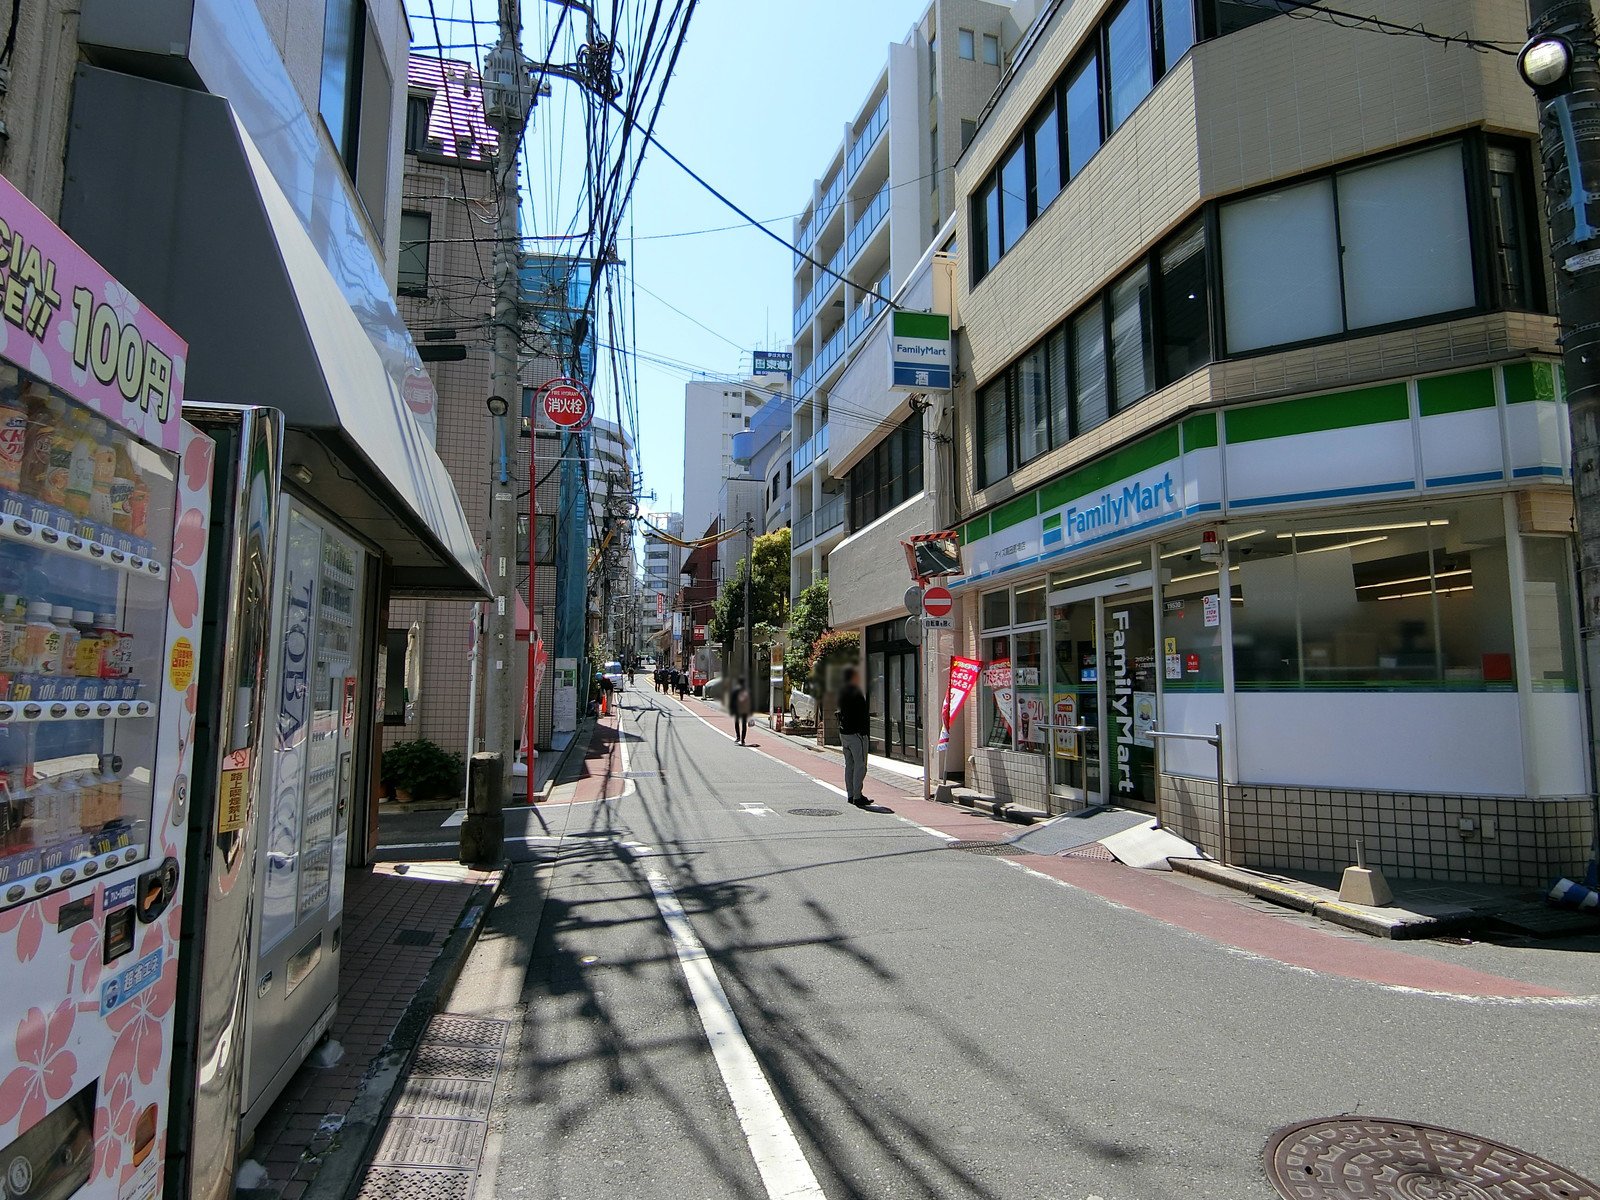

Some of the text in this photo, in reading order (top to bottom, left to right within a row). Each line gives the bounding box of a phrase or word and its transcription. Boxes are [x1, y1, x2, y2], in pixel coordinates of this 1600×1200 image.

[73, 285, 173, 424] 100円
[897, 344, 946, 356] FamilyMart
[915, 371, 929, 385] 酒
[548, 397, 583, 414] 消火栓
[1067, 472, 1174, 537] FamilyMart
[31, 508, 49, 525] 100
[57, 517, 70, 532] 100
[82, 526, 94, 540] 110
[100, 533, 114, 547] 100
[39, 685, 55, 699] 100
[61, 685, 76, 699] 100
[84, 686, 97, 700] 100
[103, 685, 118, 699] 100
[122, 685, 134, 699] 100
[1112, 610, 1134, 792] FamilyMart
[228, 772, 243, 823] 路上喫煙禁止
[98, 839, 111, 853] 110
[117, 833, 129, 848] 110
[17, 858, 33, 877] 100
[47, 851, 62, 869] 100
[124, 954, 159, 992] 超省エネ
